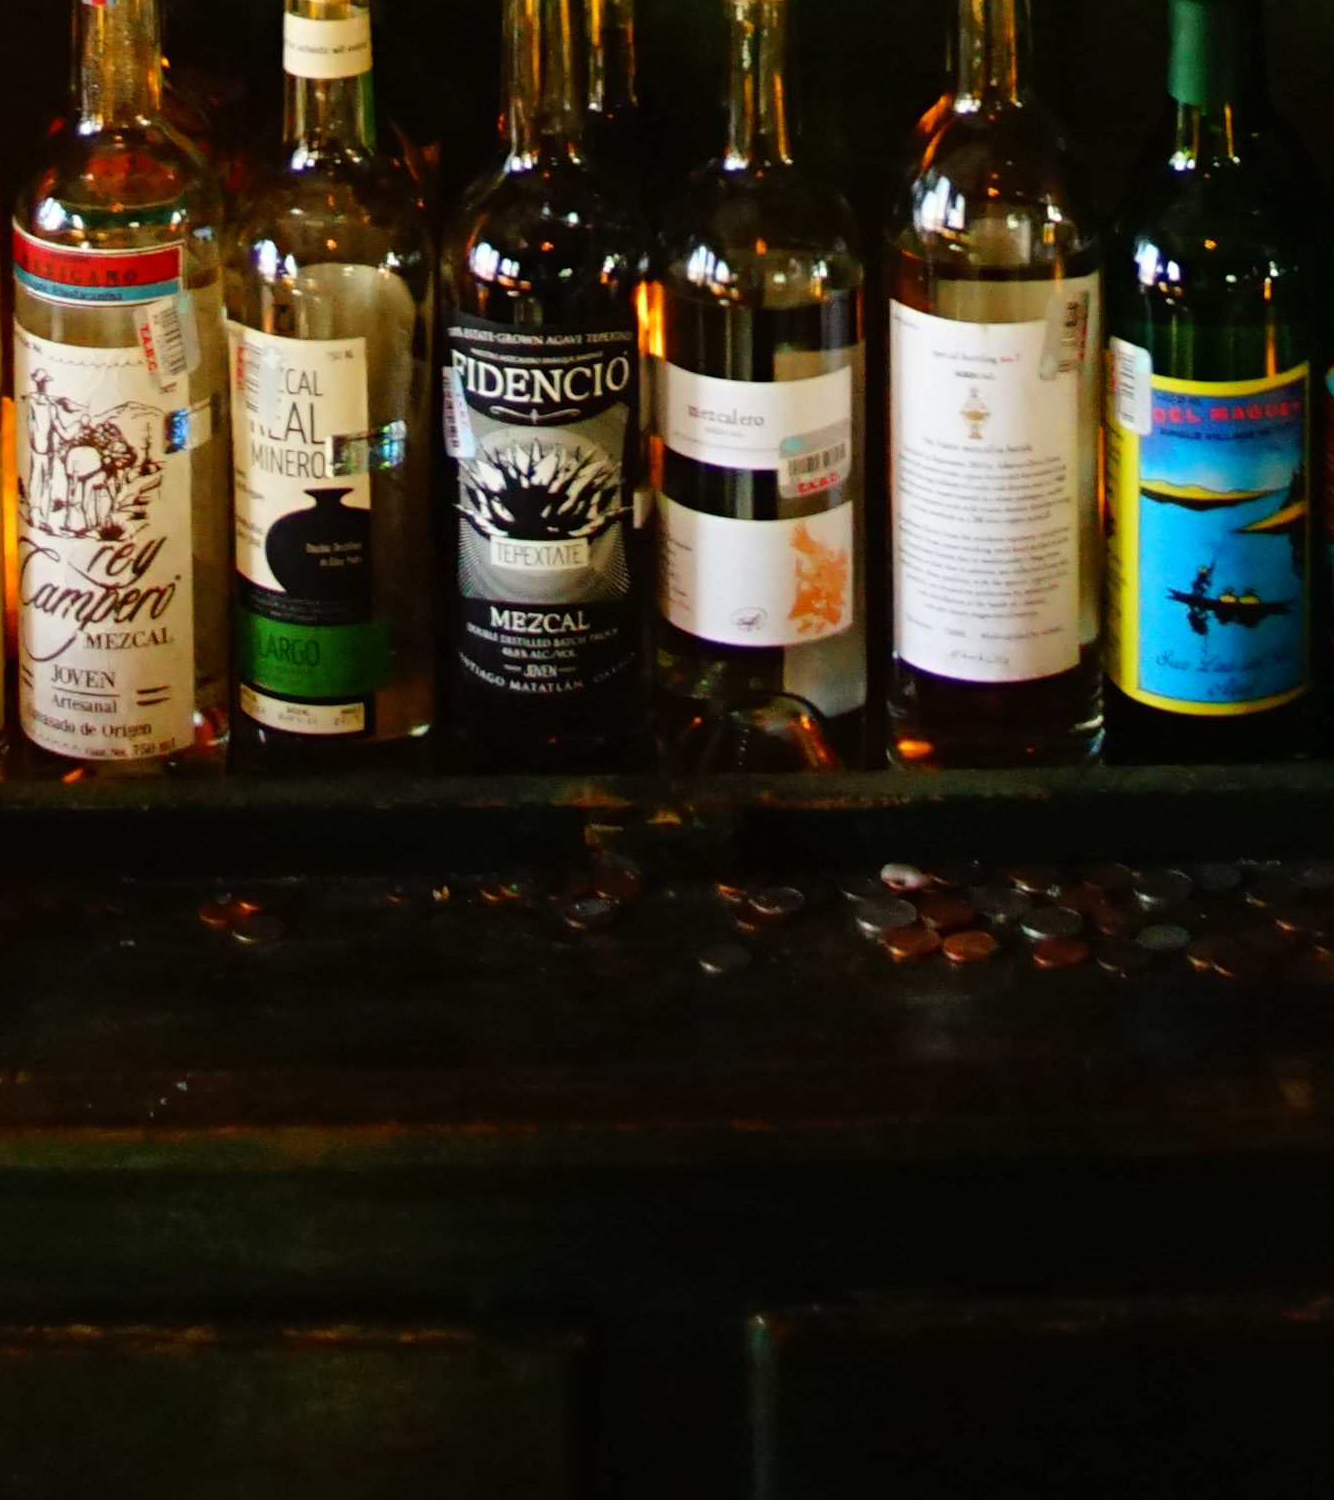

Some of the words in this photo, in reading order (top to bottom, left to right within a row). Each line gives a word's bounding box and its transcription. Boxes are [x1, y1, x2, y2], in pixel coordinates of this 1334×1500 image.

[452, 350, 630, 403] FIDENCIO
[1153, 407, 1201, 424] DEL
[251, 442, 327, 479] MINERO
[497, 543, 581, 566] TEPEXTATE
[490, 605, 591, 633] MEZCAL
[83, 628, 173, 650] MEZCAL
[500, 635, 551, 648] DISTILLED
[50, 664, 116, 689] JOVEN
[51, 694, 118, 714] Artesanal
[80, 722, 97, 736] de
[102, 722, 152, 740] Origen
